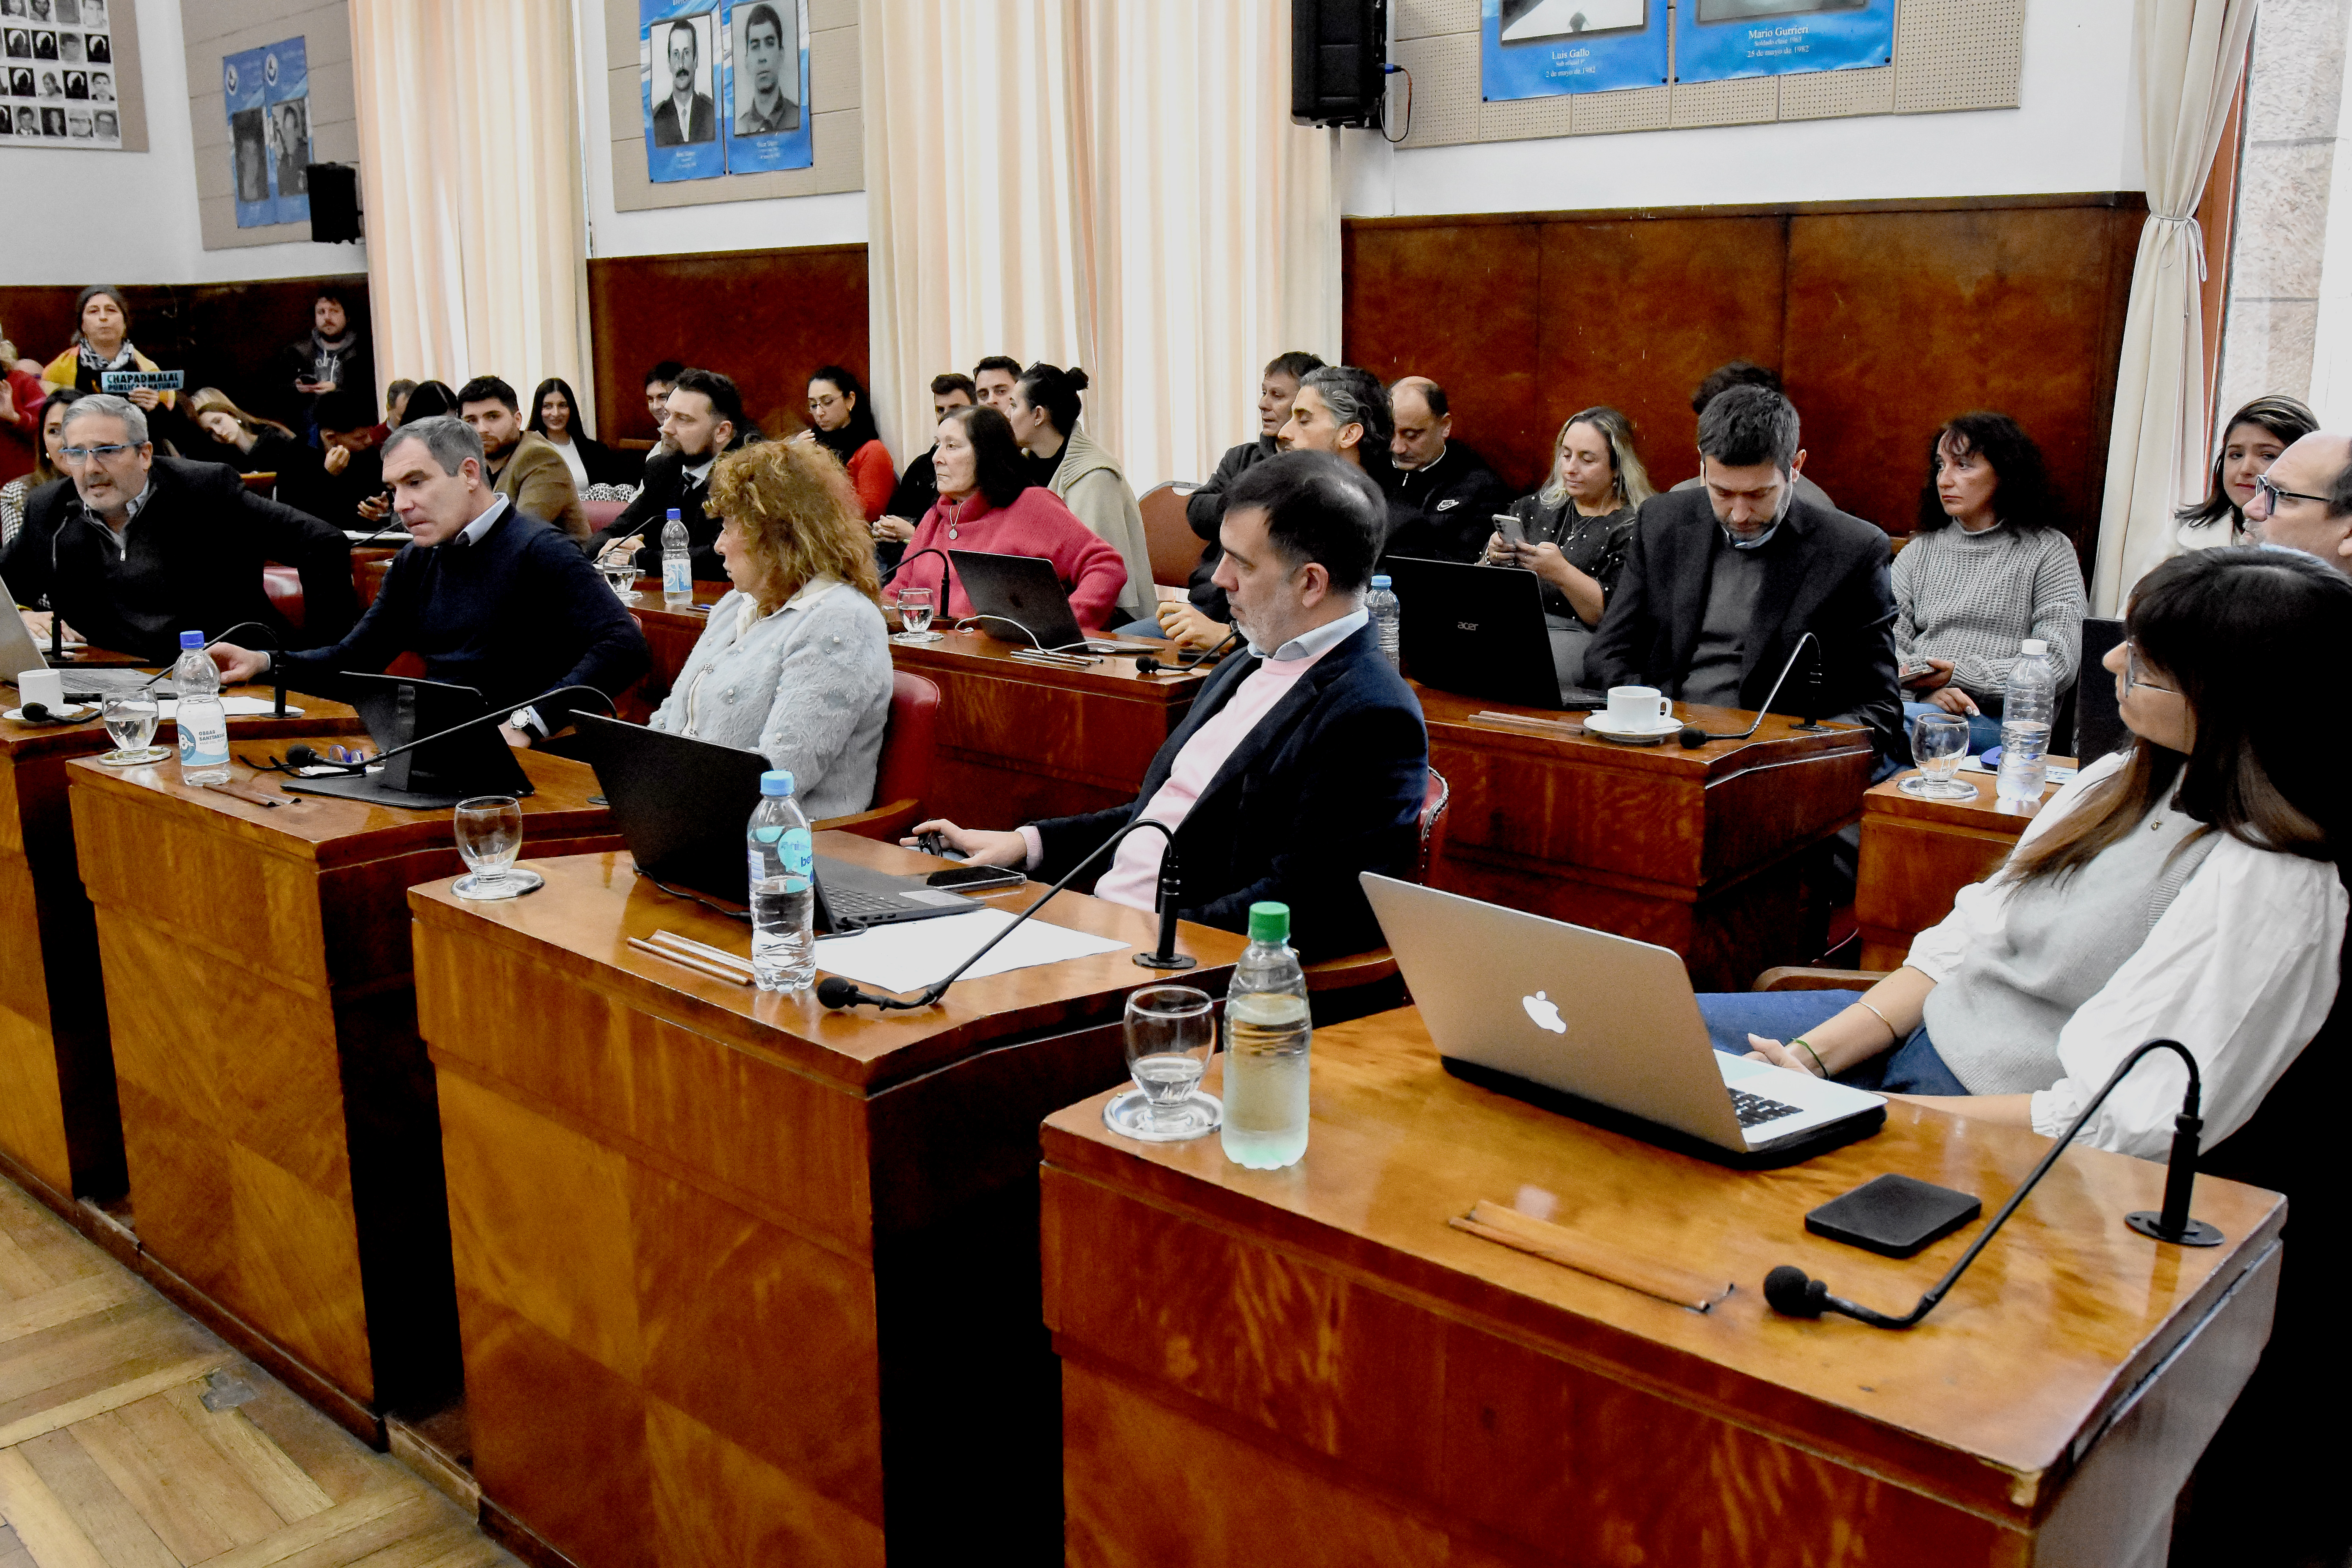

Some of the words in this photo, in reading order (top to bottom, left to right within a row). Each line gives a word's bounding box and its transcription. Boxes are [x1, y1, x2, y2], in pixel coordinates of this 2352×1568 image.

[1748, 28, 1773, 39] Mario
[1775, 24, 1809, 36] Gurrieri
[1551, 51, 1567, 60] Luis
[1569, 48, 1590, 58] Gallo
[107, 372, 178, 383] CHAPADMALAL
[1457, 621, 1479, 631] acer
